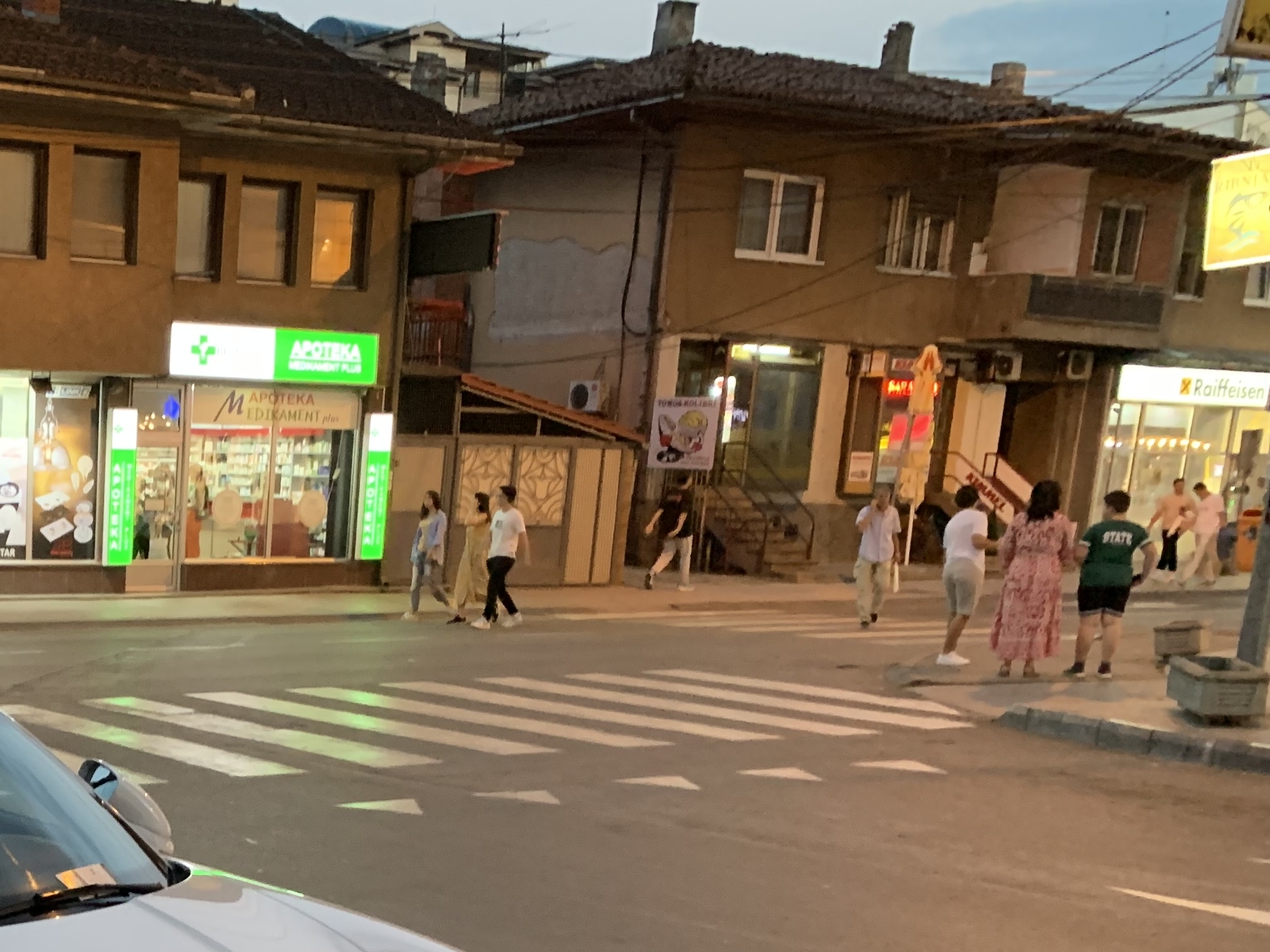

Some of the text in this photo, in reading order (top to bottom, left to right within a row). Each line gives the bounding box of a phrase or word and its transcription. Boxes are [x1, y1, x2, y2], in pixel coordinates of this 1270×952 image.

[290, 340, 361, 361] APOTEKA
[341, 363, 362, 373] PLUS
[1193, 378, 1264, 399] Raiffeisen
[249, 391, 315, 406] APOTEKA
